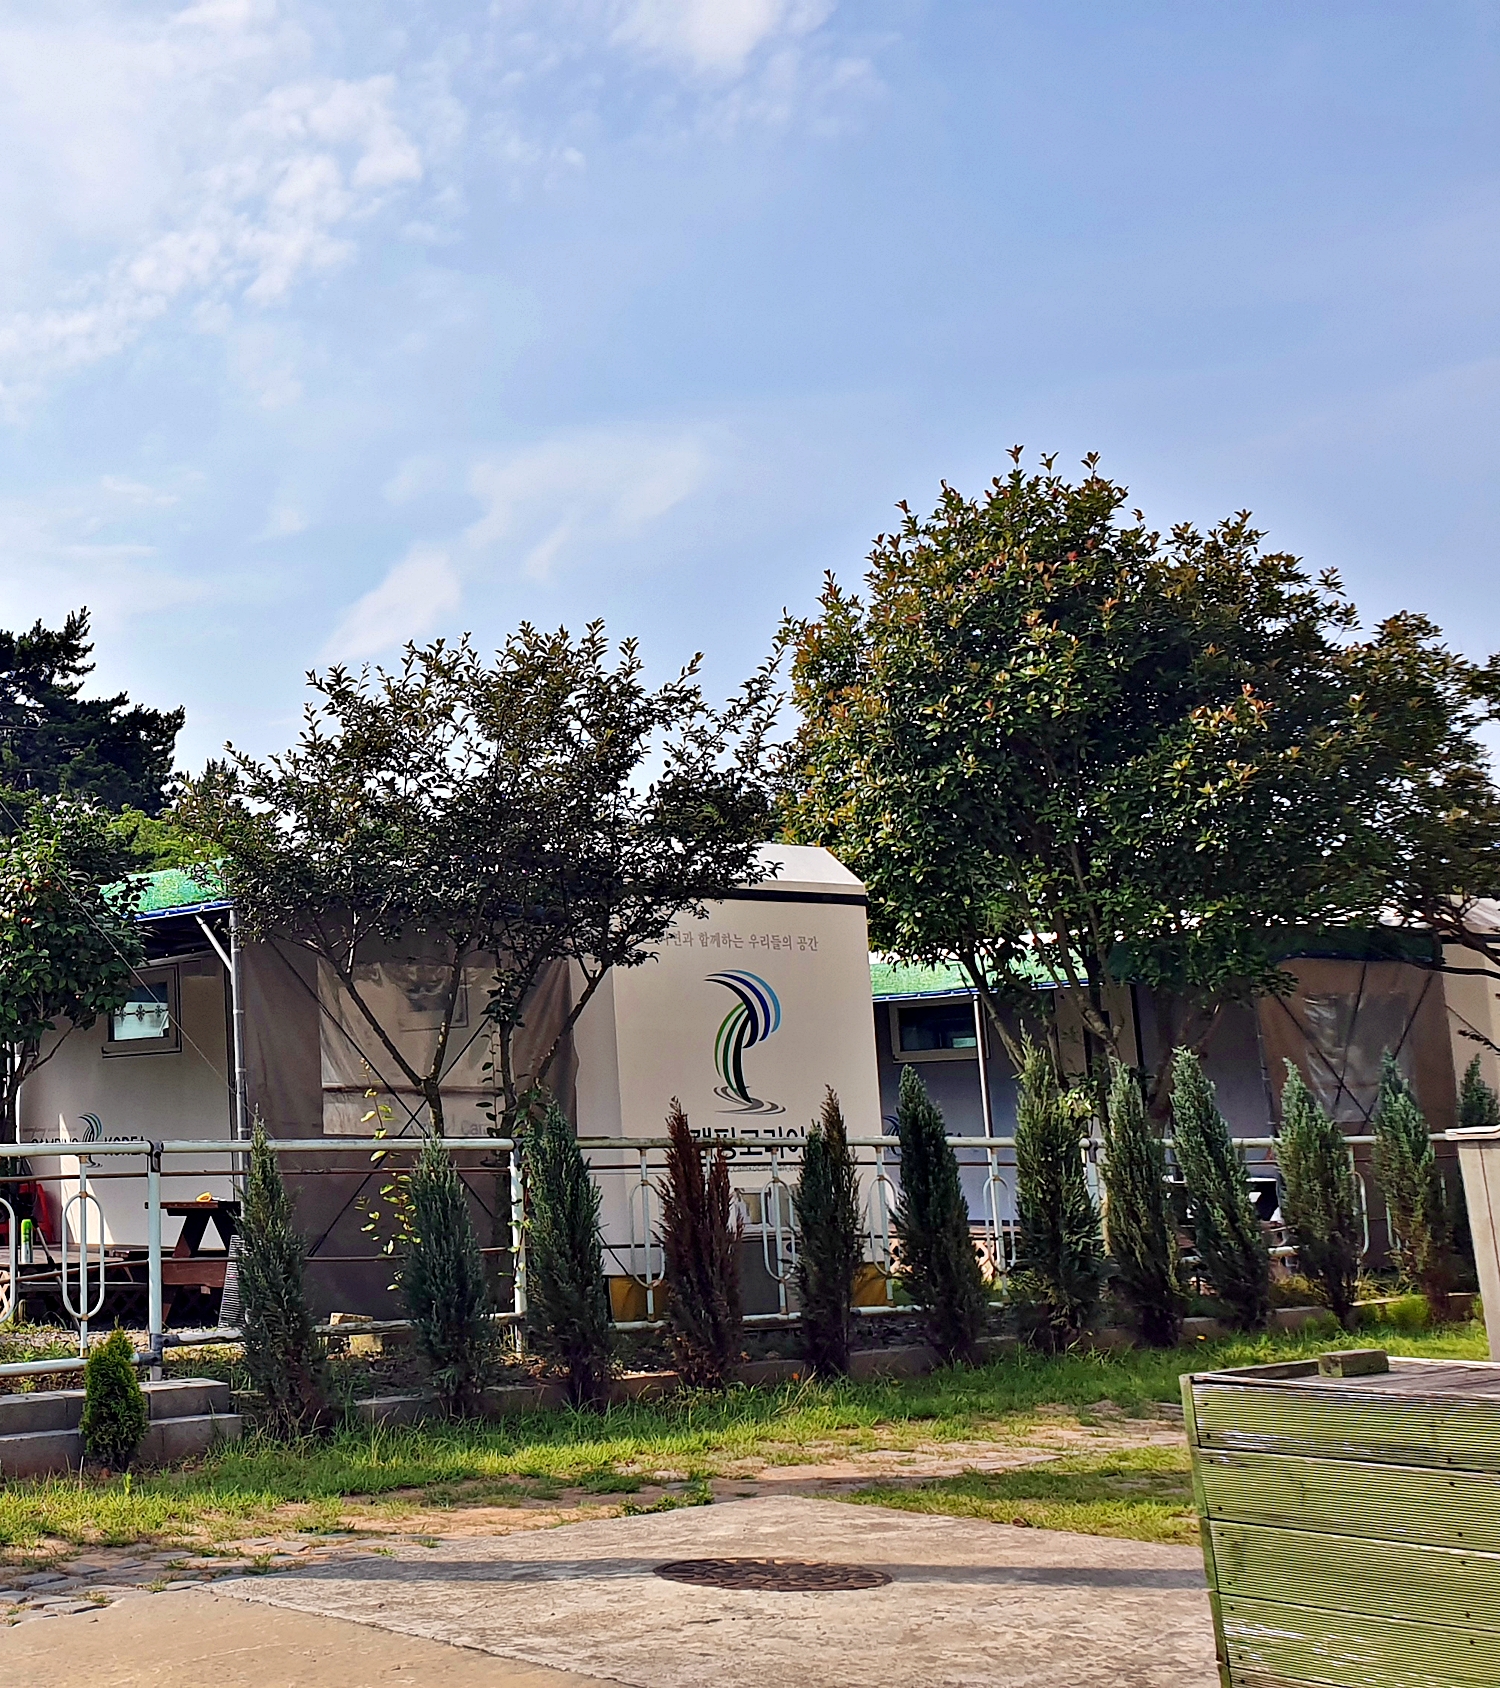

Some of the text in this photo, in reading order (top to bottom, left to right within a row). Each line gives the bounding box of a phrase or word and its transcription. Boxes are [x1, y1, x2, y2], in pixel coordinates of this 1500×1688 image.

[698, 932, 744, 949] 함께하는
[749, 934, 793, 950] 우리들의
[797, 936, 819, 951] 공간
